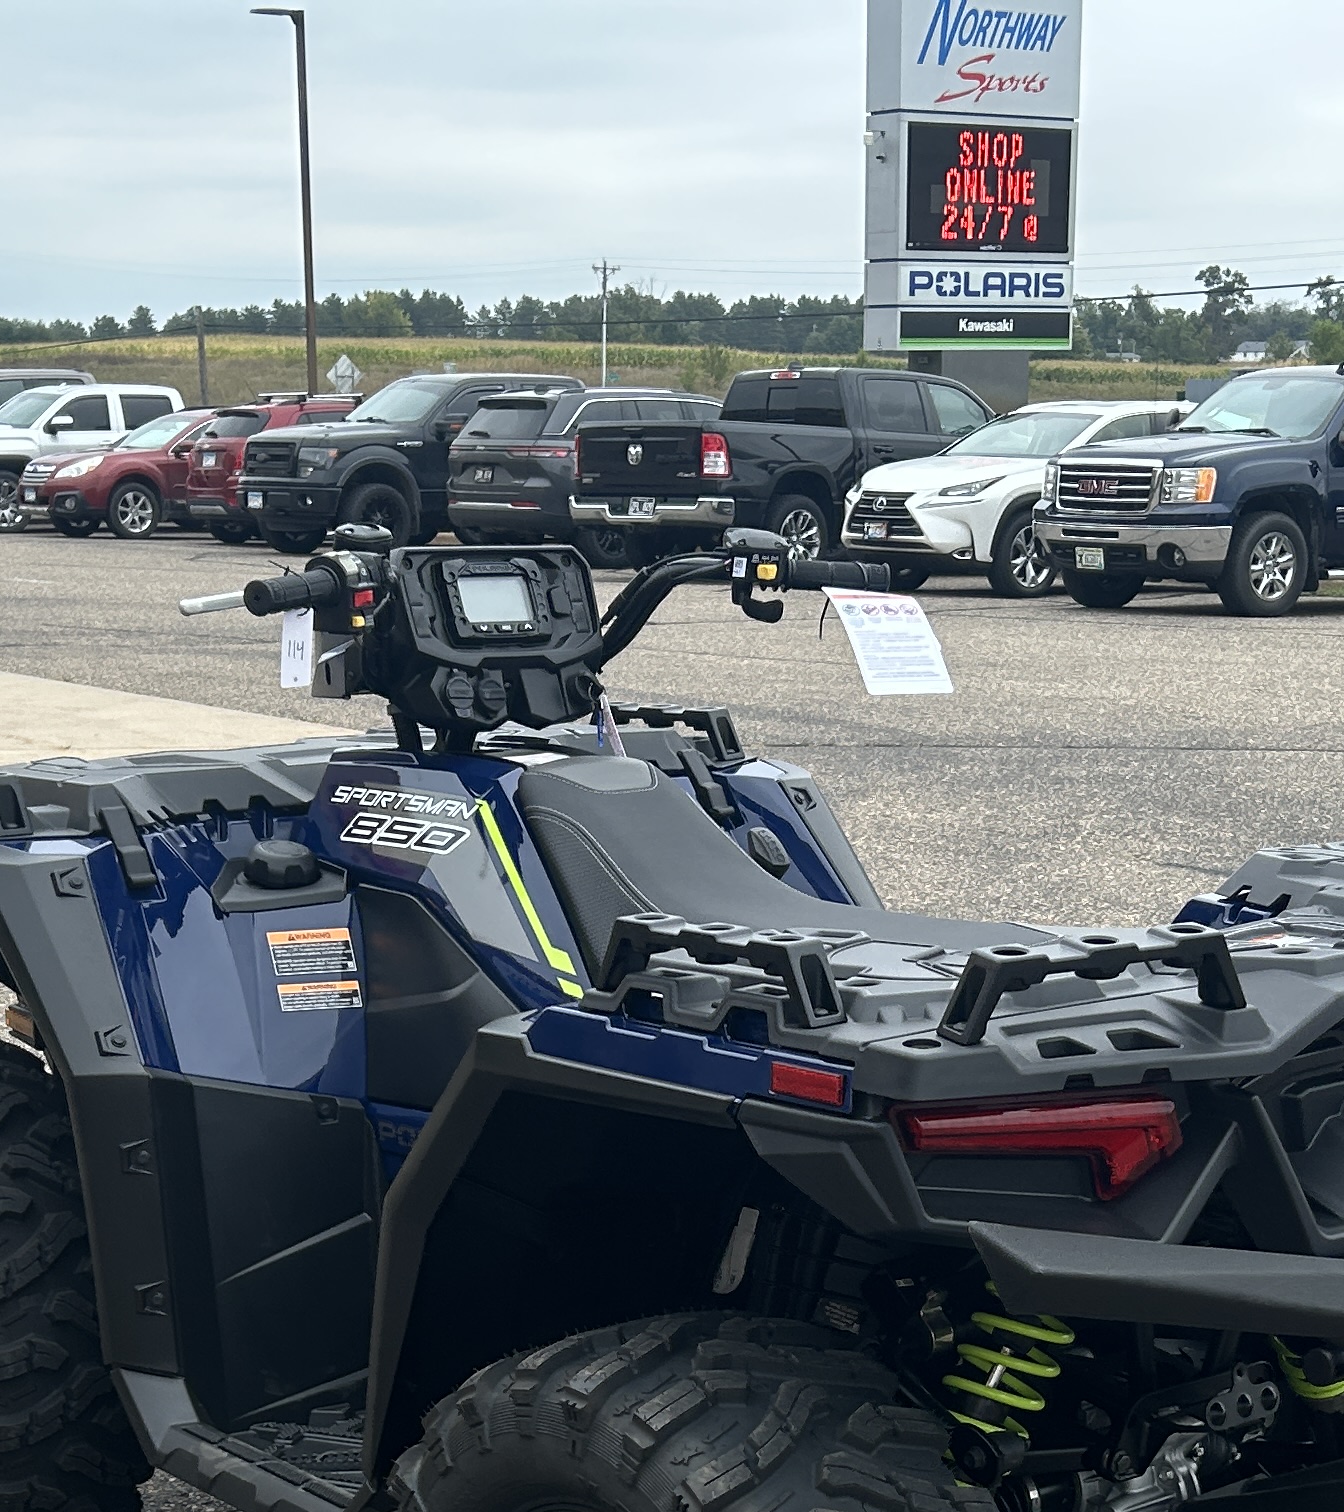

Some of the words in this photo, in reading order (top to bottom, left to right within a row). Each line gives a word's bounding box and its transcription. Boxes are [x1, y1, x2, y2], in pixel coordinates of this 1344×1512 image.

[917, 0, 1067, 65] NORTHWAY
[934, 53, 1049, 103] Sports
[959, 130, 1024, 168] SHOP
[946, 168, 1036, 205] ONLINE
[941, 204, 1014, 241] 24/7
[909, 270, 1066, 299] POLARIS
[958, 317, 1014, 333] Kawasaki
[1078, 479, 1119, 495] GMC
[288, 639, 305, 661] 114
[331, 785, 482, 820] SPORTSMAN
[339, 812, 472, 855] 850
